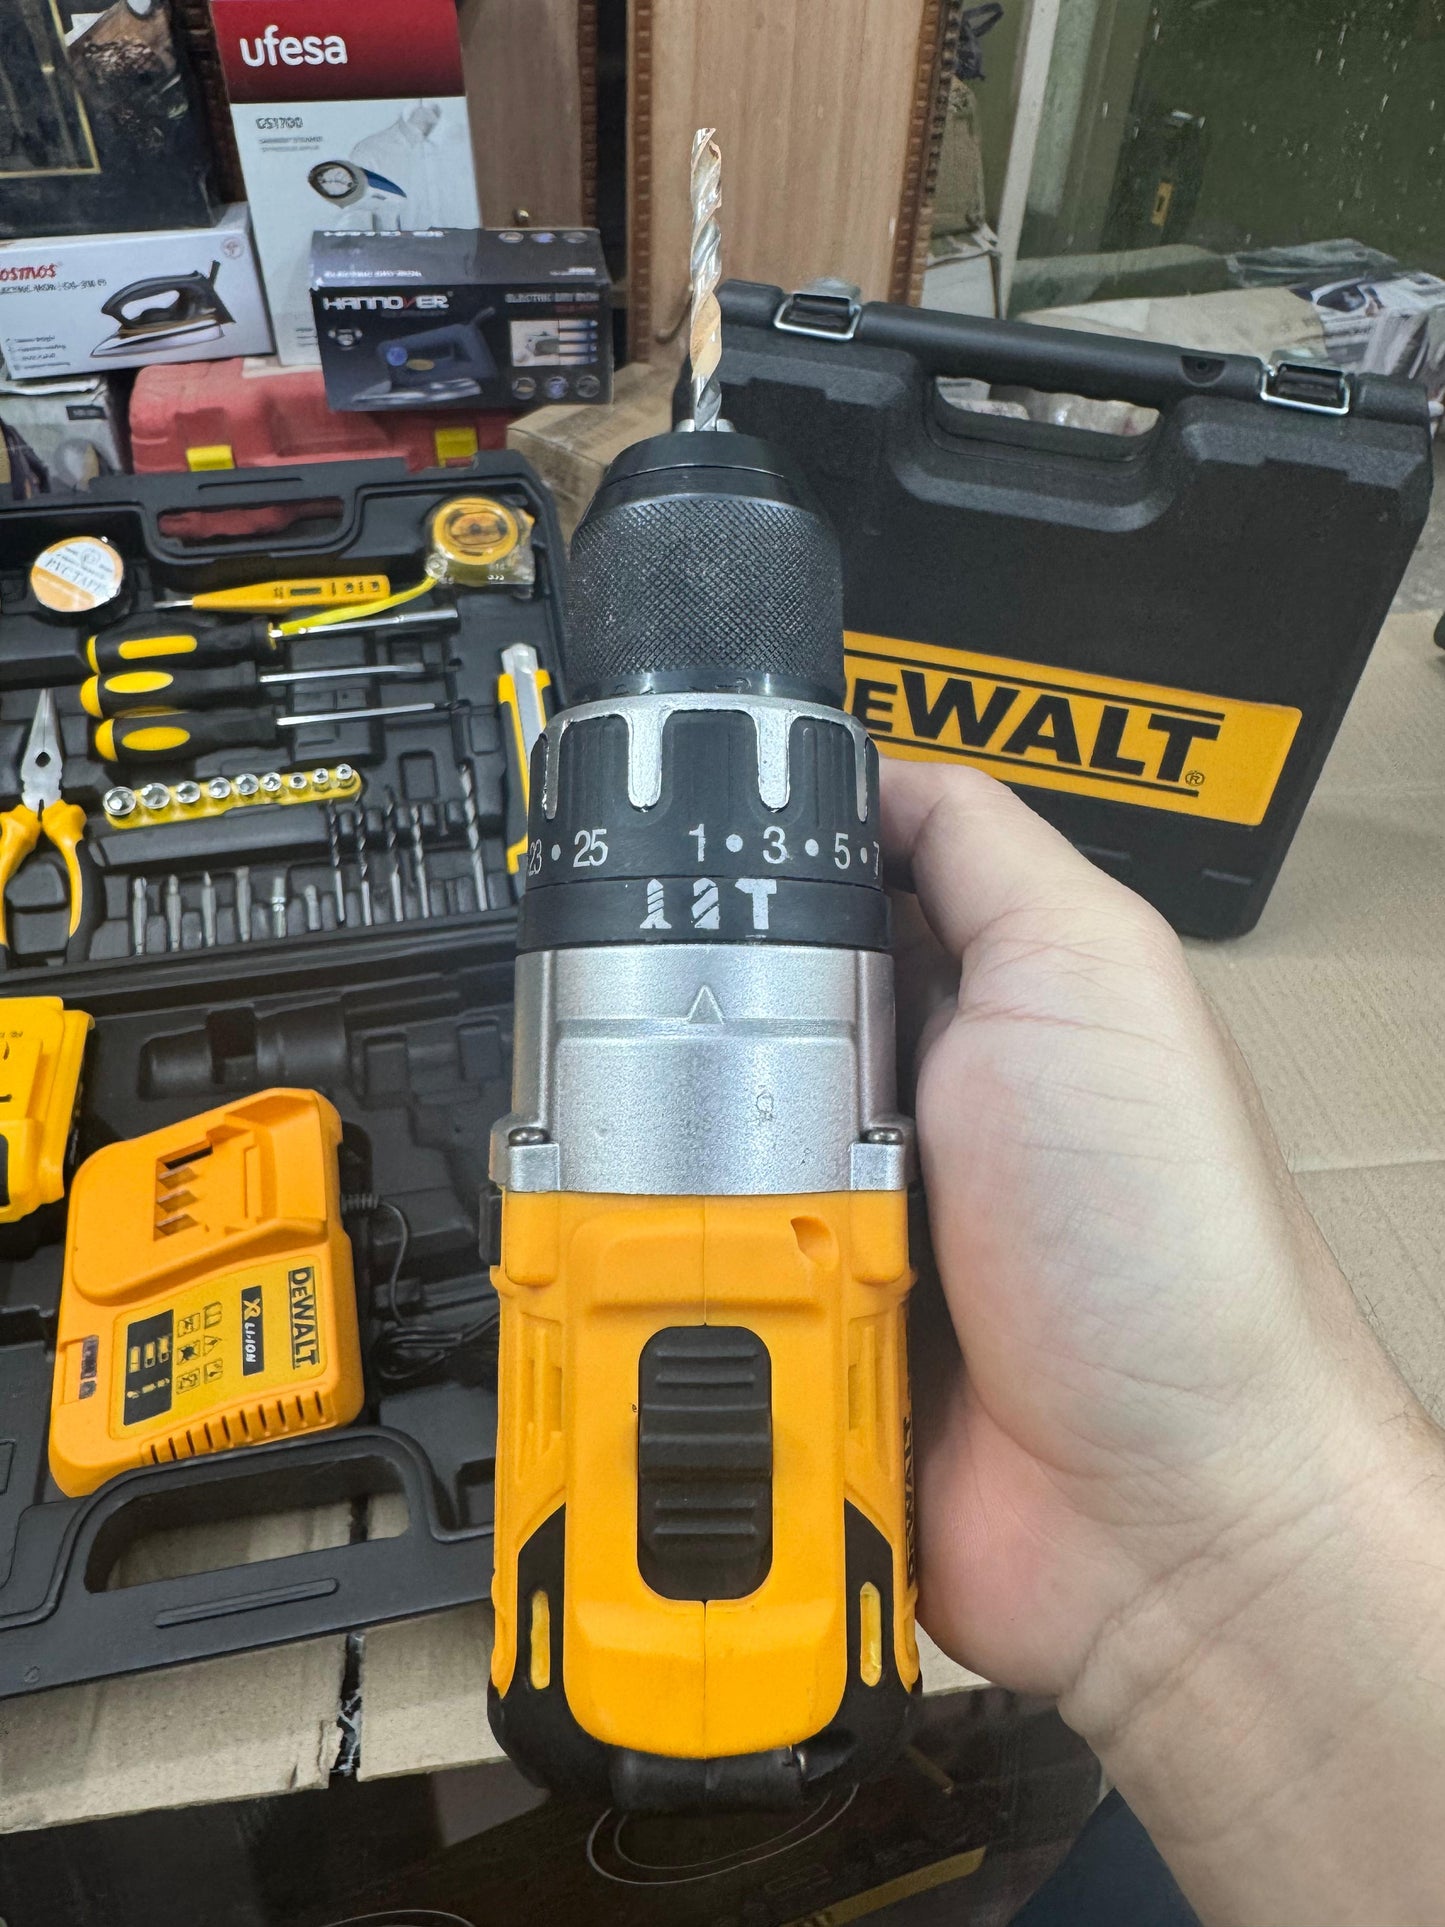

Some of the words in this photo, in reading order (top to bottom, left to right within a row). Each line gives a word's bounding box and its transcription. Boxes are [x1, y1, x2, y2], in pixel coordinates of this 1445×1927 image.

[240, 24, 348, 67] ufesa
[851, 669, 1221, 784] EWALT
[528, 838, 542, 876] 23
[573, 828, 608, 868] 25
[689, 823, 706, 862] 1
[763, 826, 788, 864] 3
[834, 833, 851, 870] 5
[291, 1266, 317, 1367] DEWALT
